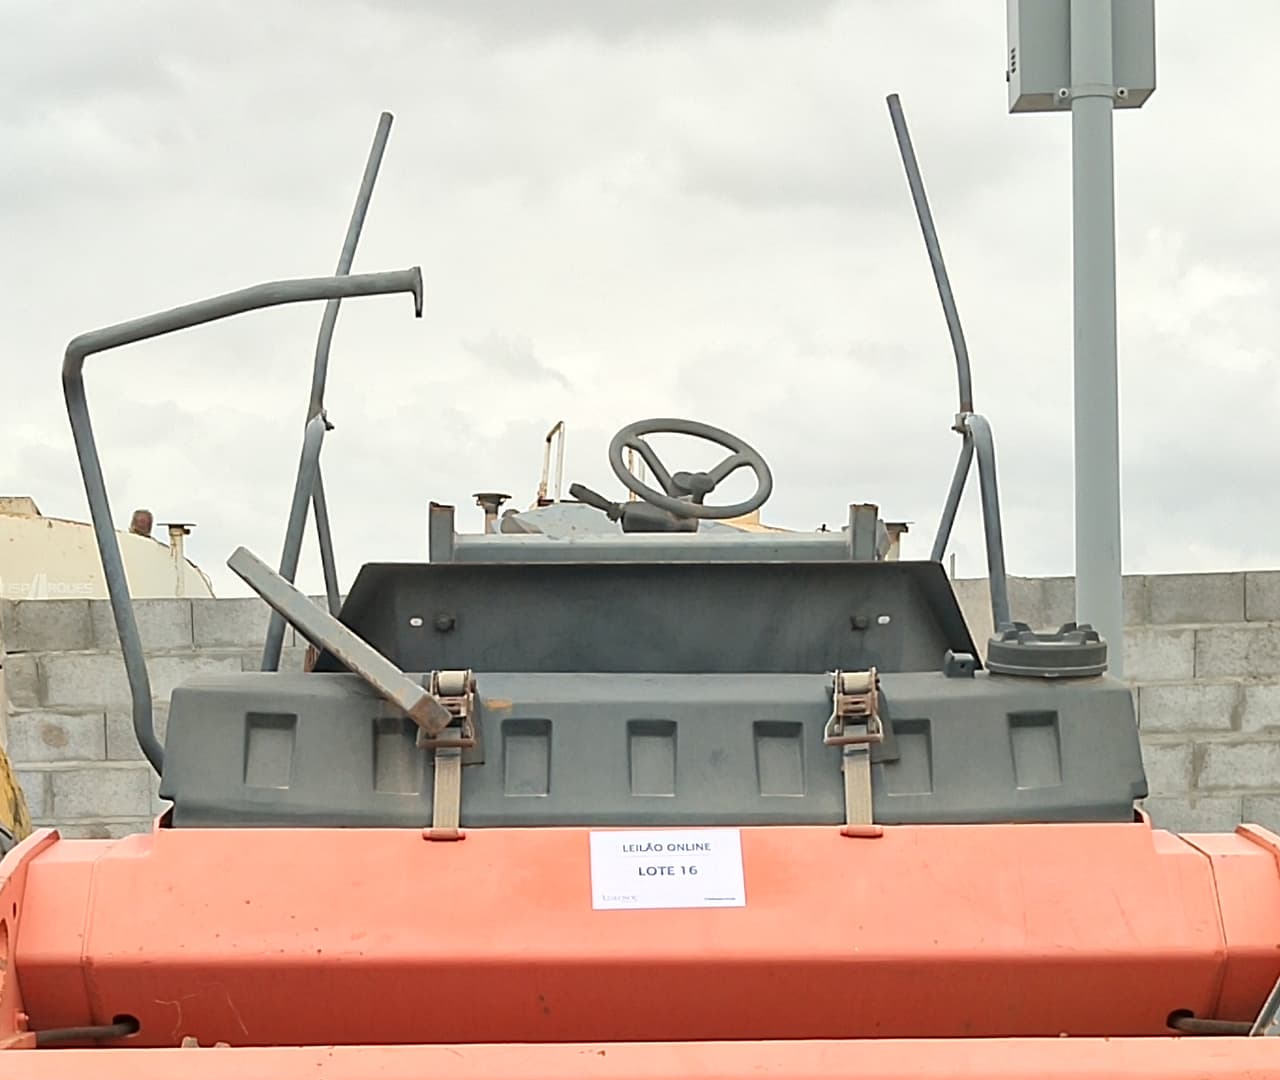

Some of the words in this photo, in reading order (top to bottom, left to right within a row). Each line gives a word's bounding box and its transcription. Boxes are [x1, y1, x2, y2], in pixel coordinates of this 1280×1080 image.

[622, 842, 663, 853] LEILÃO
[666, 842, 712, 852] ONLINE
[638, 866, 675, 876] LOTE
[681, 865, 698, 876] 16
